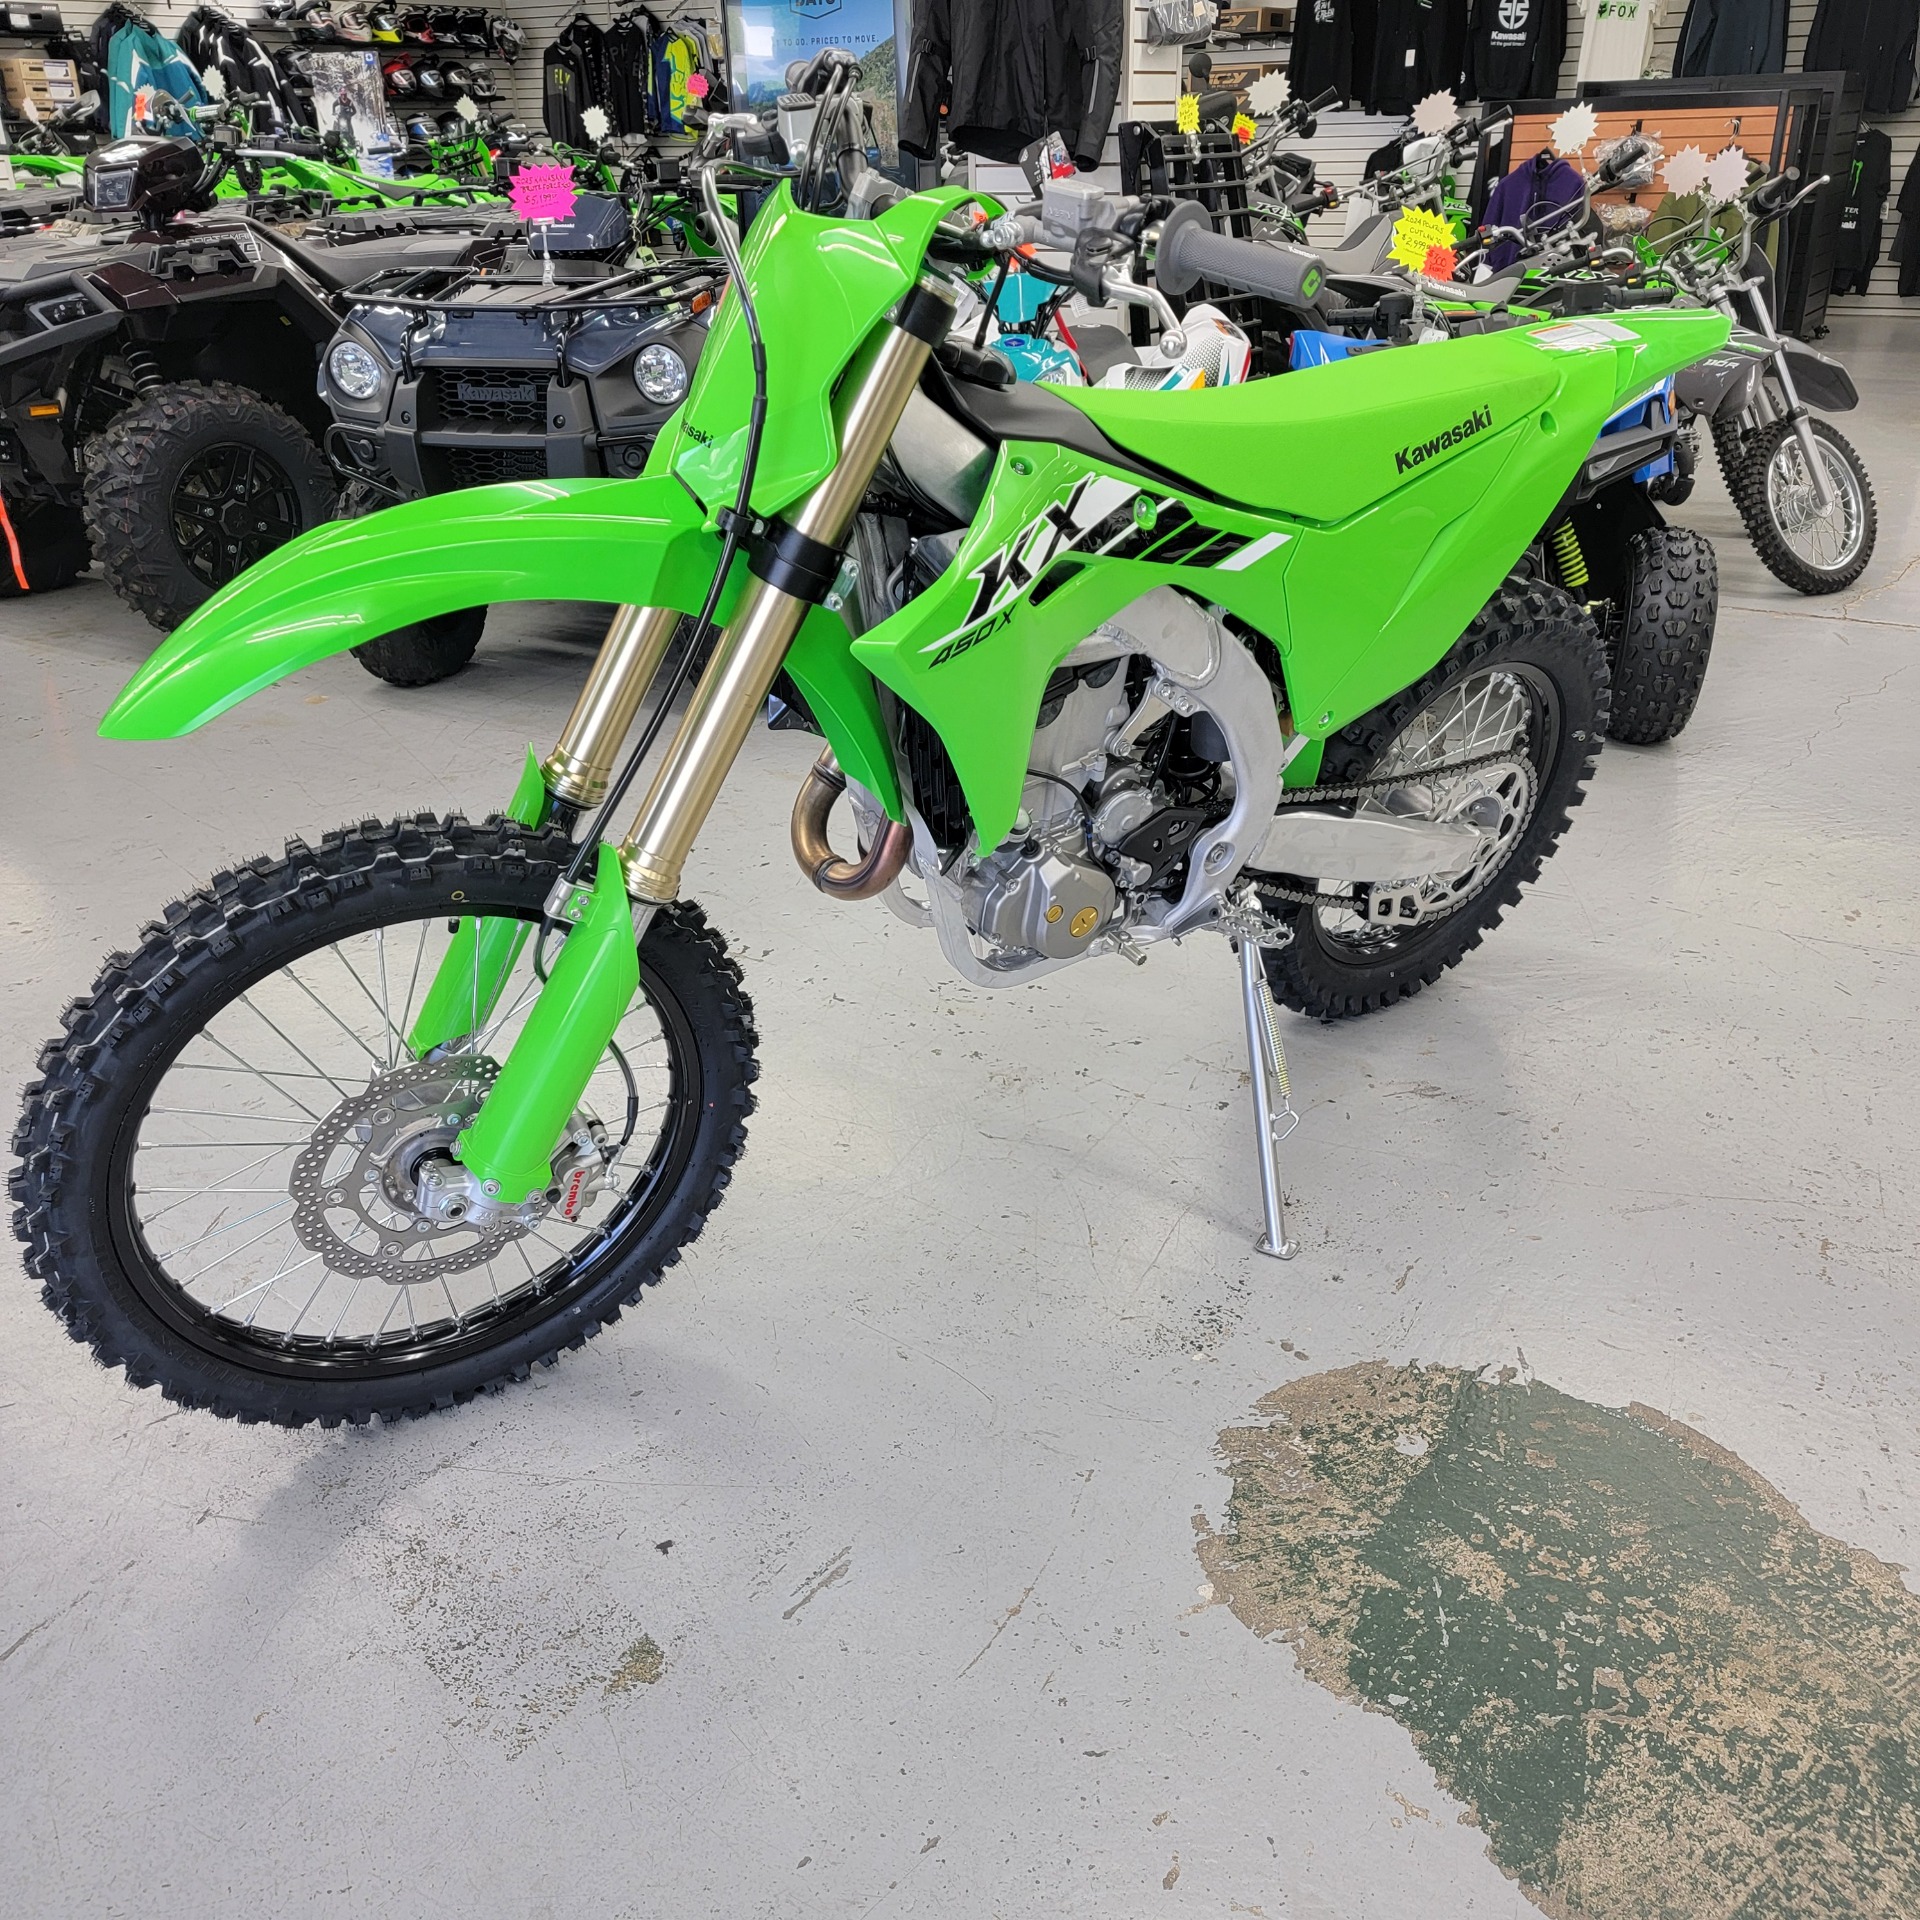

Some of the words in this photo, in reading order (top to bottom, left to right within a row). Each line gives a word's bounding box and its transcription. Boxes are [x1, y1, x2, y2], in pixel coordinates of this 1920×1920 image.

[1608, 5, 1638, 18] FOX
[811, 37, 839, 46] PRICED
[842, 35, 852, 44] TO
[855, 34, 879, 43] MOVE.
[554, 68, 571, 85] FLY
[534, 173, 567, 184] KAWASAKI
[1405, 214, 1422, 225] 2024
[1427, 281, 1467, 298] Kawasaki
[457, 382, 537, 401] Kawasaki
[1394, 403, 1493, 475] Kawasaki
[962, 472, 1091, 629] KX
[564, 1170, 586, 1216] brembo
